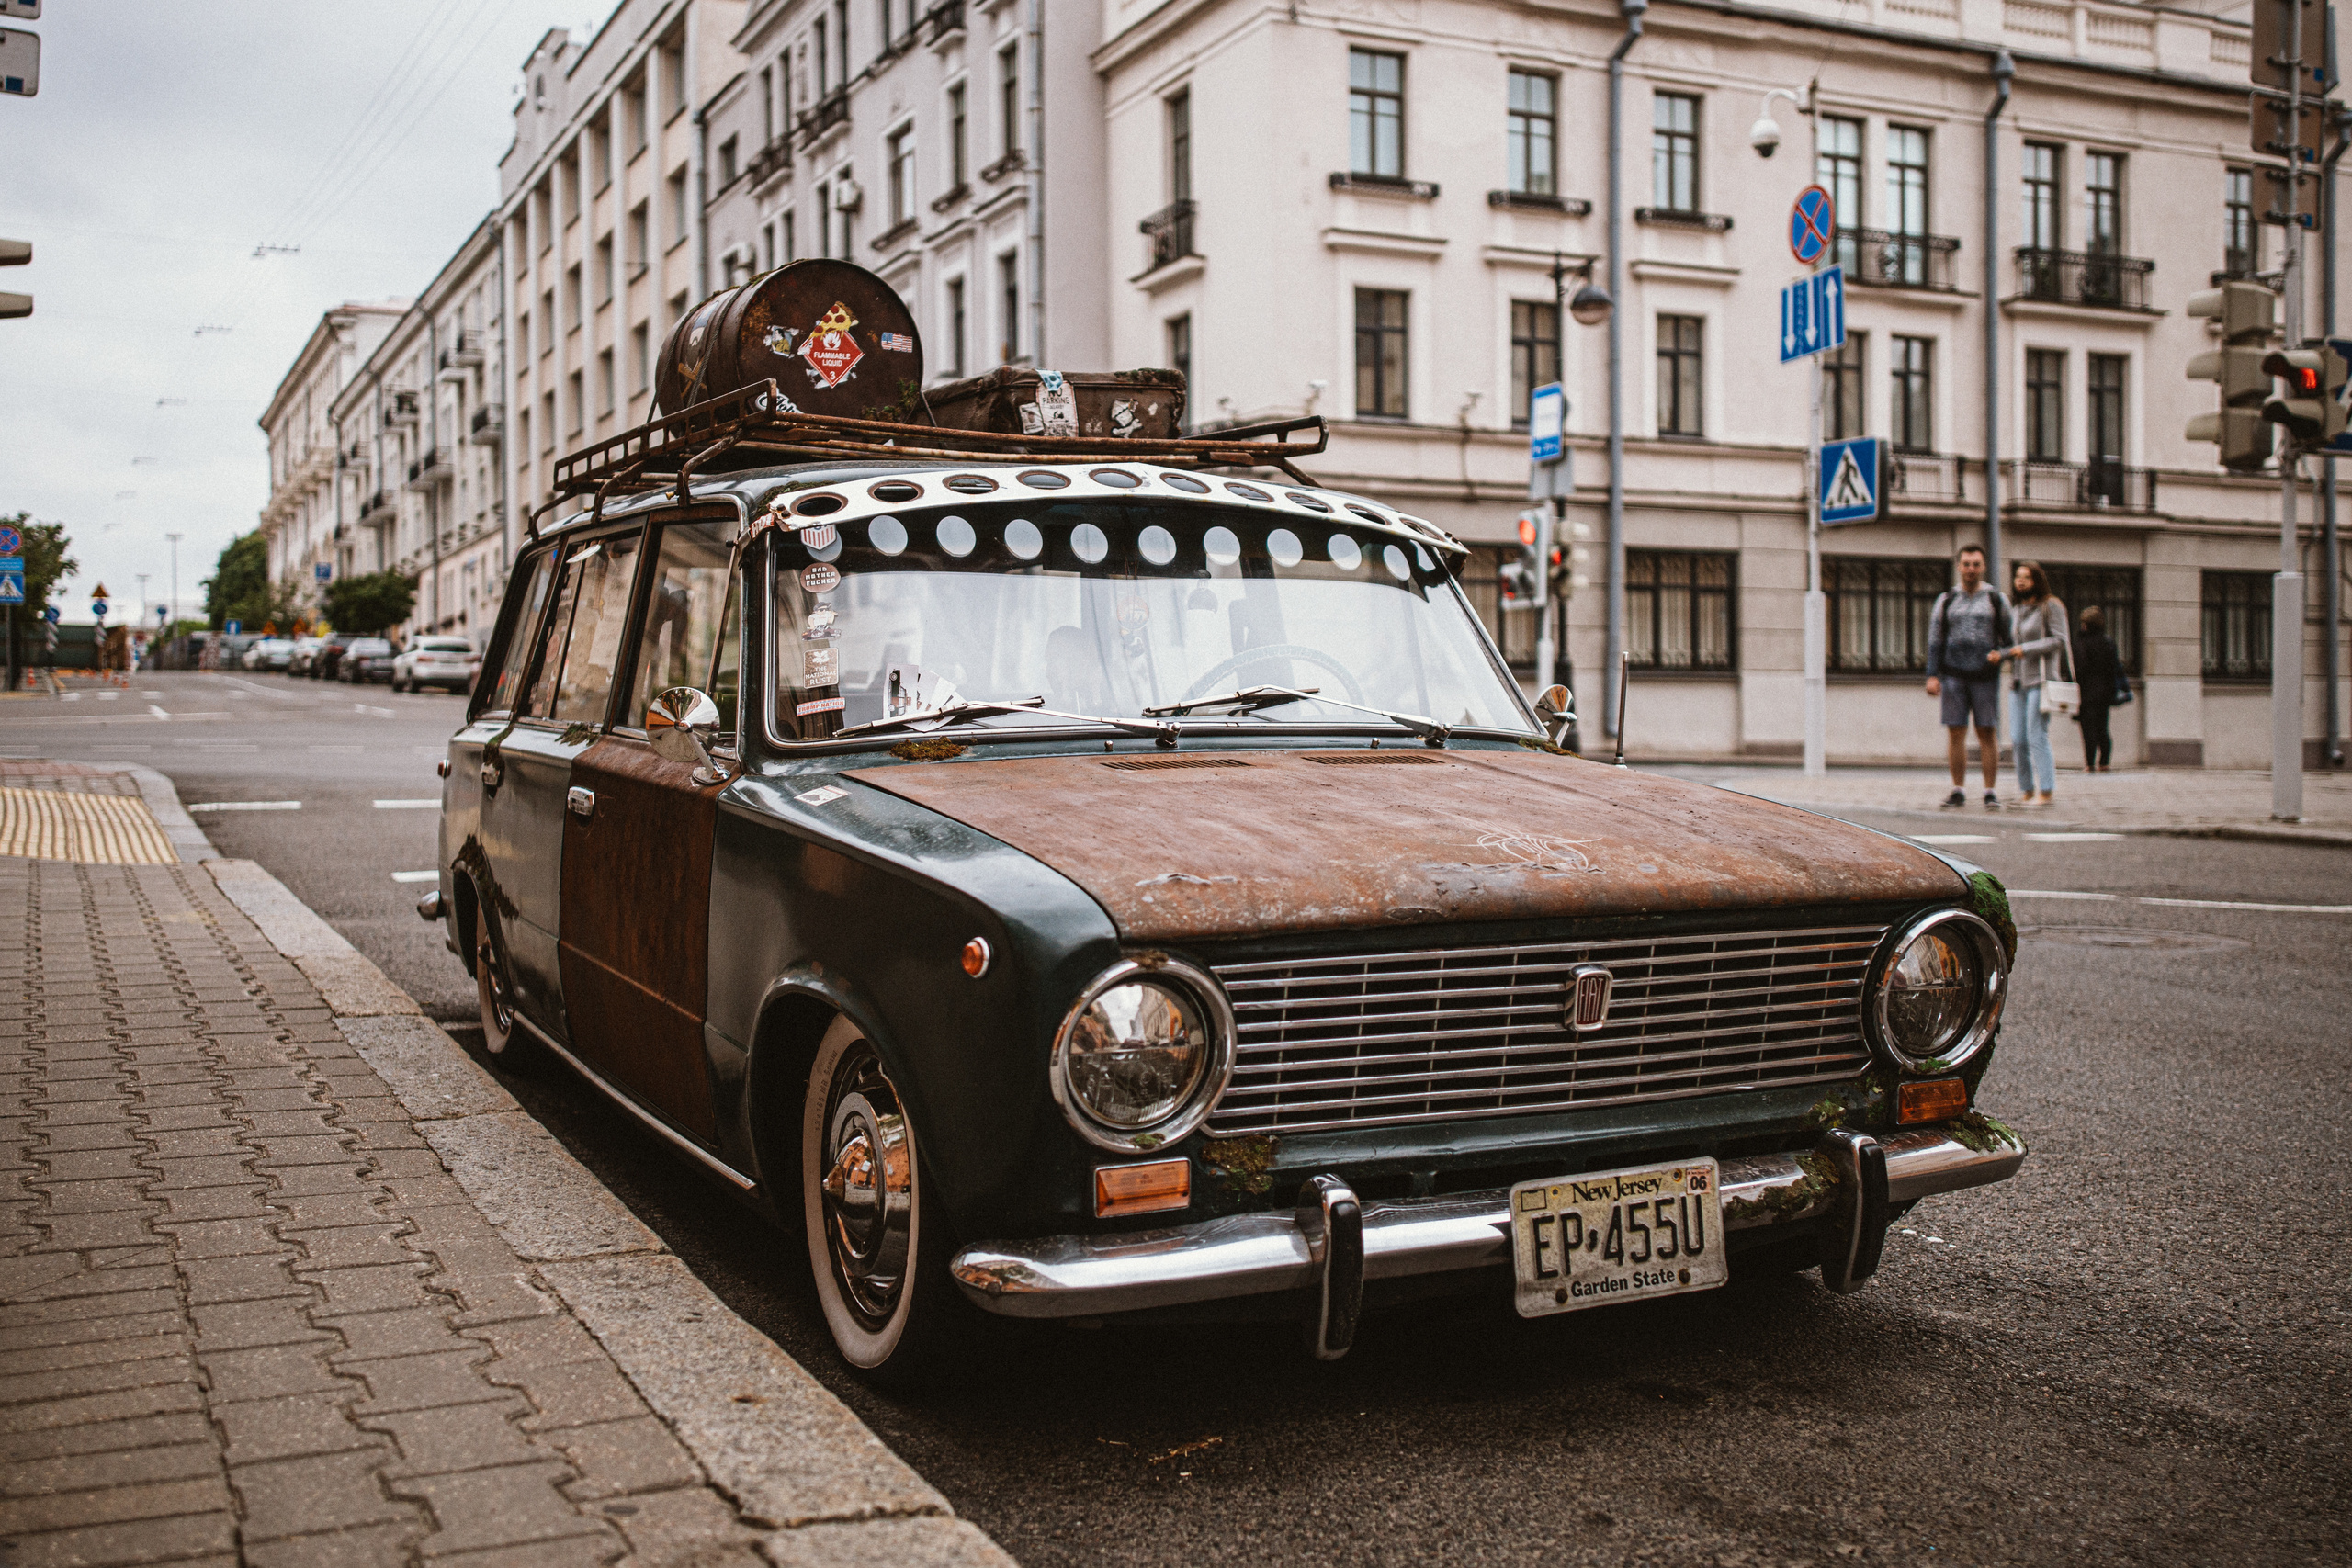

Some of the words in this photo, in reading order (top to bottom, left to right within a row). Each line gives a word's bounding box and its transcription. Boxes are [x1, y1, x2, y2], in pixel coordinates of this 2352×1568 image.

[814, 352, 851, 360] FLAMMABLE
[830, 371, 836, 379] 3
[805, 571, 836, 581] MOTHER
[806, 578, 836, 587] FUCKER
[805, 671, 837, 680] NATIONAL
[809, 676, 832, 685] RUST
[798, 704, 820, 713] TRUMP
[1577, 977, 1604, 1021] FIAT
[1690, 1175, 1707, 1190] 06
[1570, 1181, 1612, 1204] New
[1612, 1176, 1663, 1201] Jersey
[1570, 1276, 1629, 1298] Garden
[1633, 1269, 1676, 1287] State
